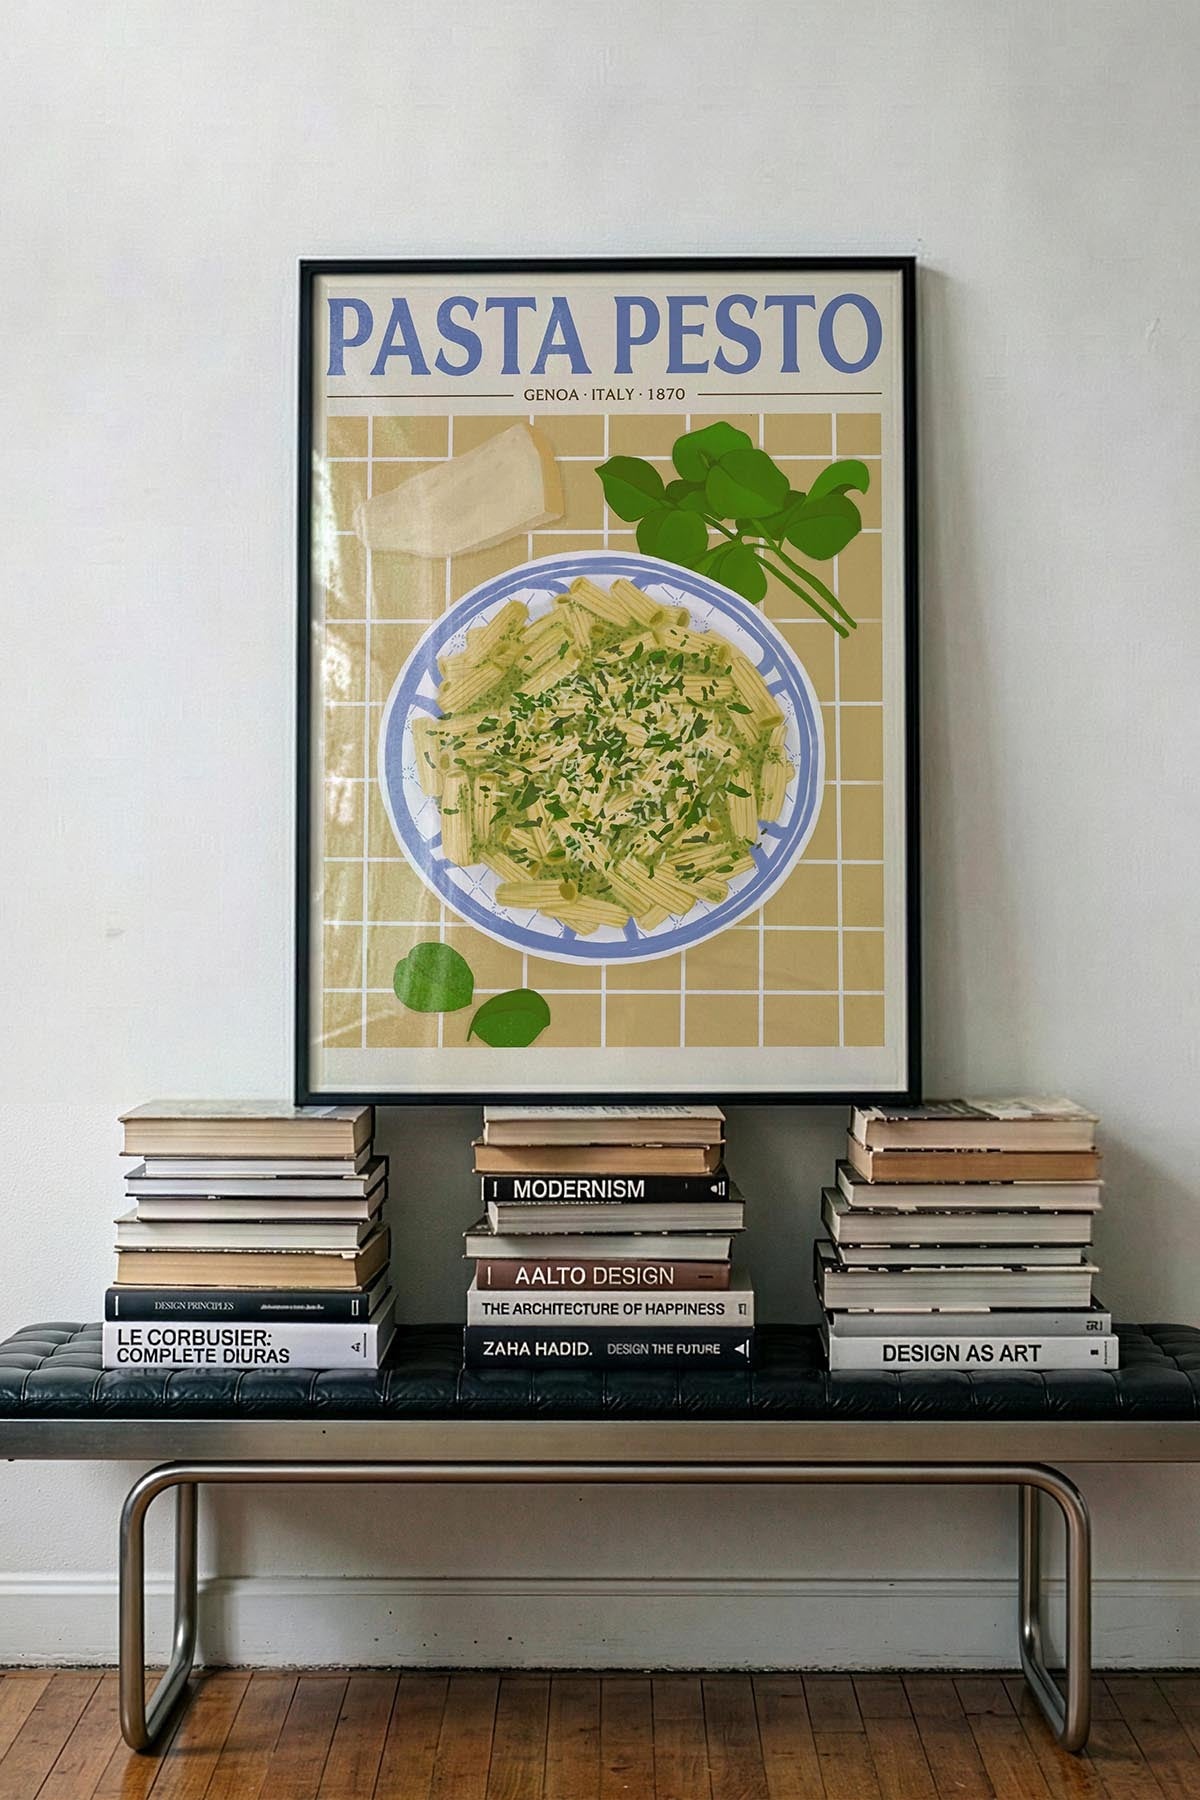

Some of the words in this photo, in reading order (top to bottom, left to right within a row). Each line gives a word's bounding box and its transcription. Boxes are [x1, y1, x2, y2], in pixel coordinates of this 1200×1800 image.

[326, 295, 592, 376] PASTA
[613, 293, 883, 375] PESTO
[523, 388, 579, 401] GENOA
[592, 388, 634, 400] ITALY
[648, 388, 686, 401] 1870
[513, 1179, 645, 1199] MODERNISM
[515, 1266, 586, 1285] AALTO
[593, 1266, 674, 1285] DESIGN
[154, 1301, 186, 1310] DESIGN
[187, 1301, 235, 1310] PRINCIPLES
[482, 1302, 510, 1316] THE
[512, 1302, 619, 1316] ARCHITECTURE
[623, 1302, 642, 1316] OF
[645, 1302, 725, 1316] HAPPINESS
[118, 1328, 143, 1346] LE
[147, 1328, 272, 1347] CORBUSIER:
[117, 1347, 217, 1364] COMPLETE
[223, 1348, 290, 1364] DIURAS
[483, 1341, 531, 1356] ZAHA
[535, 1341, 593, 1356] HADID.
[607, 1343, 649, 1355] DESIGN
[651, 1343, 674, 1355] THE
[676, 1343, 721, 1355] FUTURE
[882, 1344, 960, 1363] DESIGN
[965, 1344, 994, 1363] AS
[999, 1344, 1042, 1363] ART
